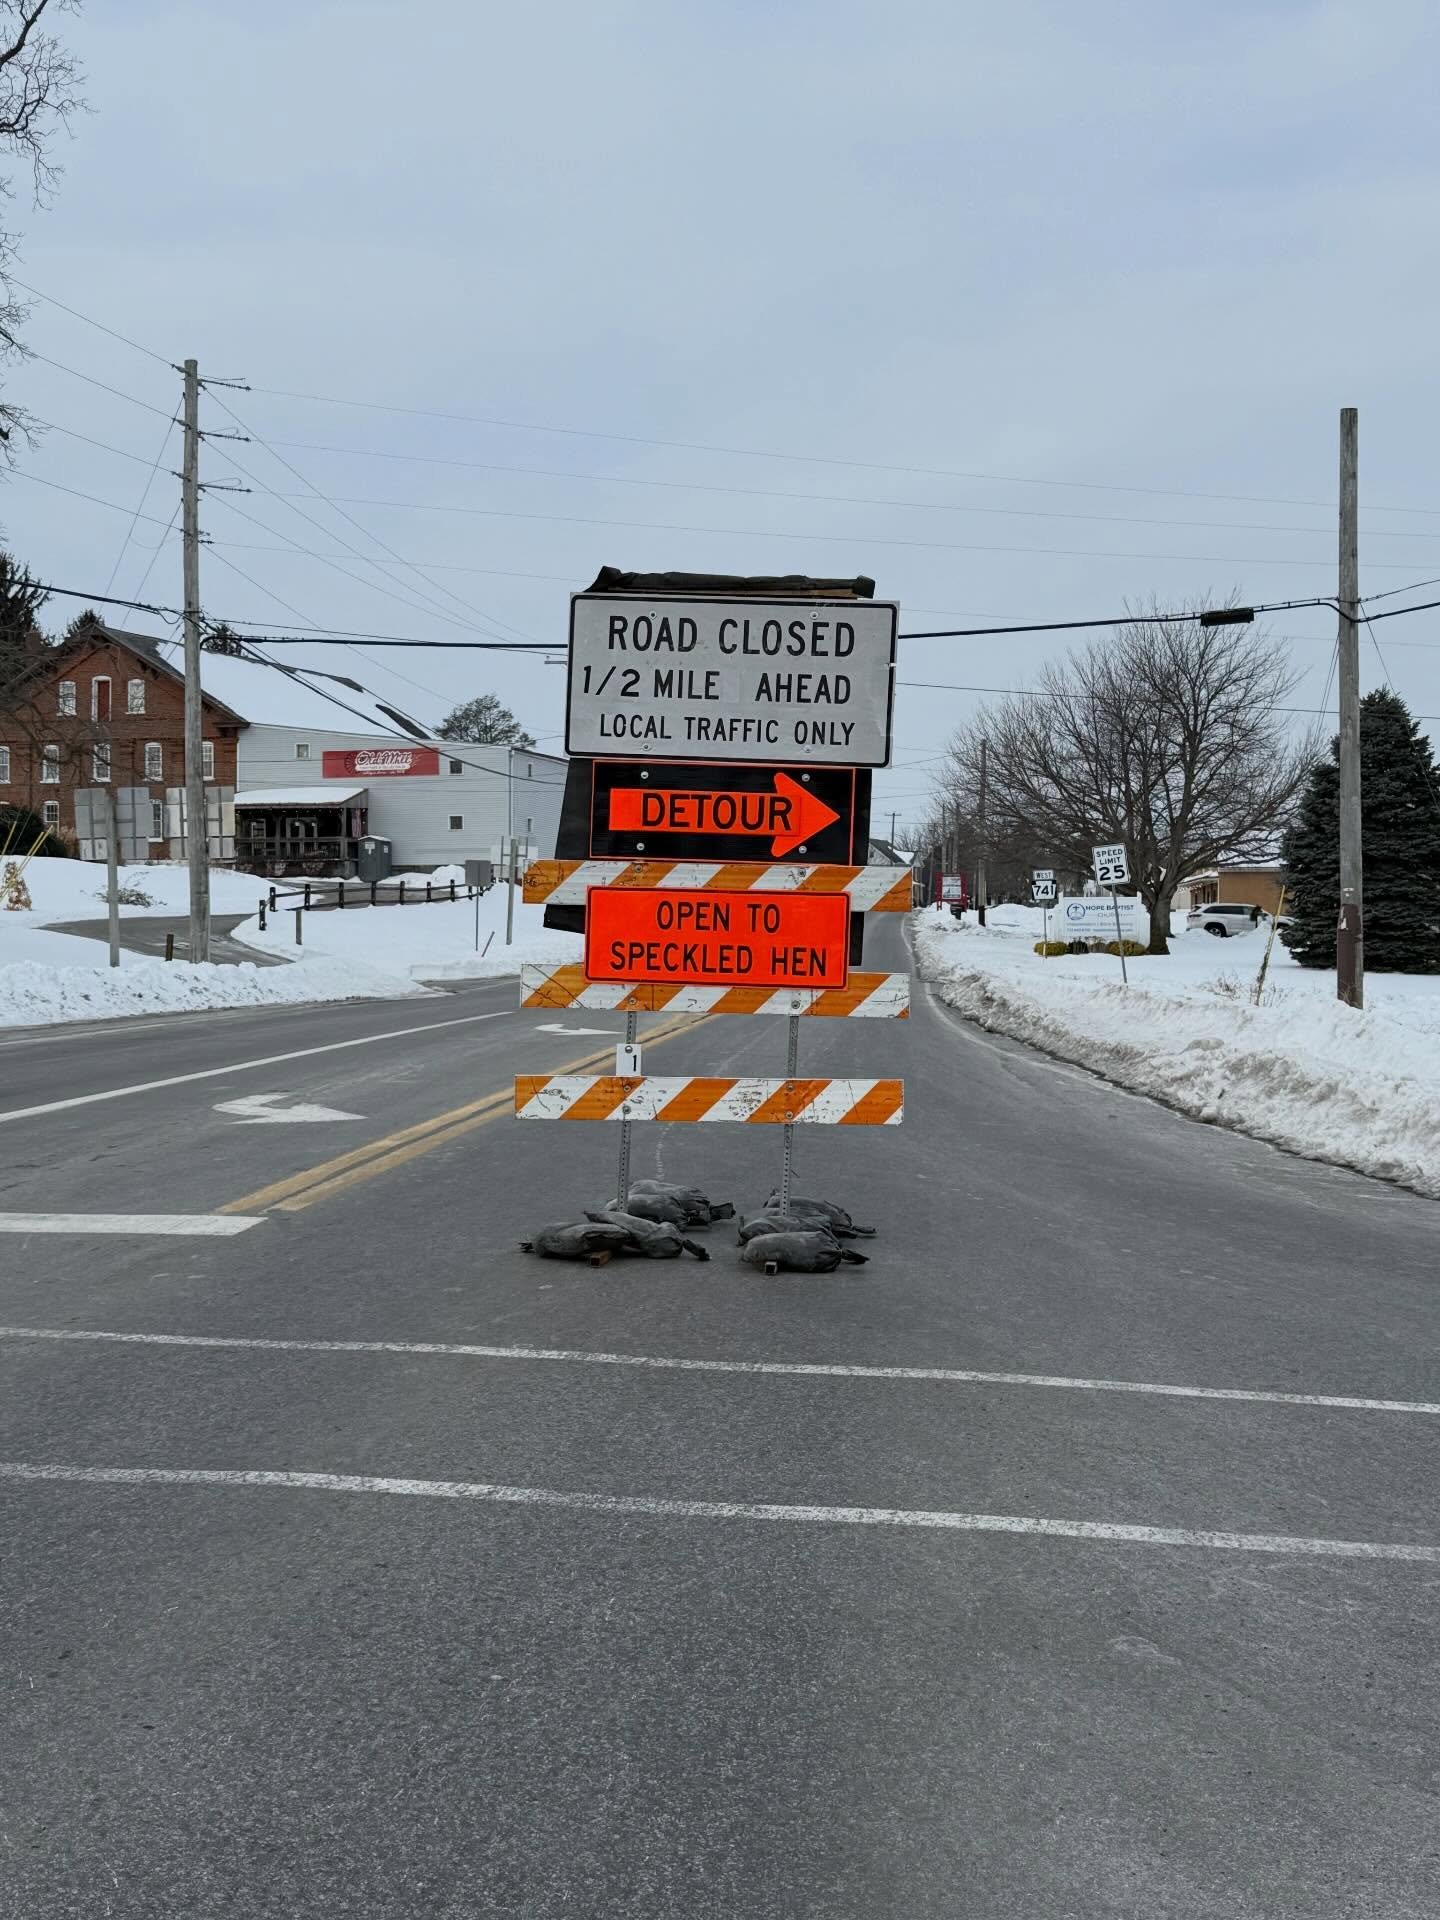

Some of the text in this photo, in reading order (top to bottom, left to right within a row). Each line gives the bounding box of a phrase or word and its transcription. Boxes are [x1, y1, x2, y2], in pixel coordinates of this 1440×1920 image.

[608, 615, 855, 657] ROAD CLOSED
[583, 665, 851, 705] 1/2 MILE AHEAD
[599, 713, 856, 746] LOCAL TRAFFIC ONLY
[641, 792, 793, 831] DETOUR
[1096, 849, 1123, 857] SPEED
[1099, 857, 1121, 865] LIMIT
[1036, 871, 1051, 879] WEST
[1099, 865, 1125, 880] 25
[1033, 884, 1054, 897] 741
[656, 900, 780, 933] OPEN TO
[609, 941, 827, 977] SPECKLED HEN
[632, 1054, 638, 1072] 1
